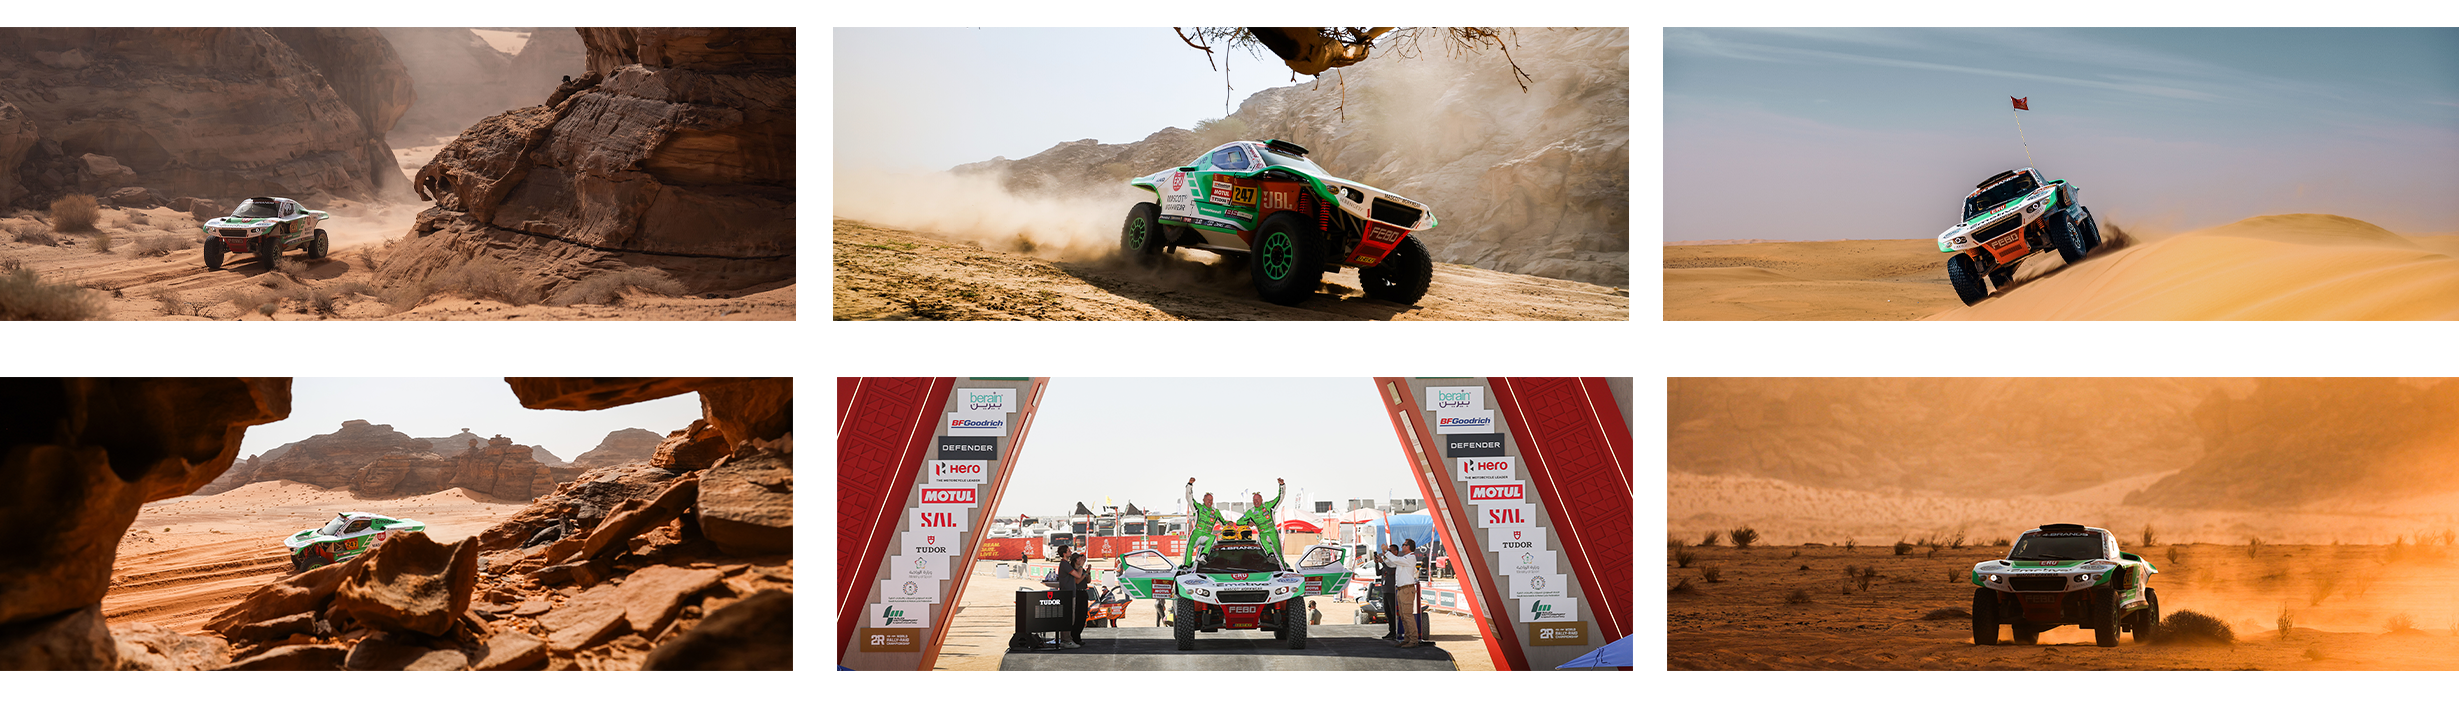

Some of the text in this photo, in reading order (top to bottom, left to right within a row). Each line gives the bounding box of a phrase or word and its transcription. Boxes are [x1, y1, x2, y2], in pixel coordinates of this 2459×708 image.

[1213, 189, 1230, 197] MOTUL
[1235, 187, 1255, 203] 247
[1264, 192, 1293, 210] JBL
[1369, 226, 1400, 242] FEBO
[1991, 232, 2019, 249] FEBO
[970, 391, 1003, 403] berain
[1438, 389, 1470, 402] berain
[951, 419, 1003, 427] BFGoodrich
[1440, 417, 1491, 425] BFGoodrich
[1450, 441, 1501, 449] DEFENDER
[950, 464, 981, 474] Hero
[1478, 461, 1508, 471] Hero
[924, 490, 974, 502] MOTUL
[1472, 486, 1521, 498] MOTUL
[1502, 541, 1533, 549] TUDOR
[2025, 595, 2055, 603] FEBO
[1229, 606, 1257, 614] FEBO
[1540, 628, 1554, 639] 2R
[871, 634, 885, 646] 2R
